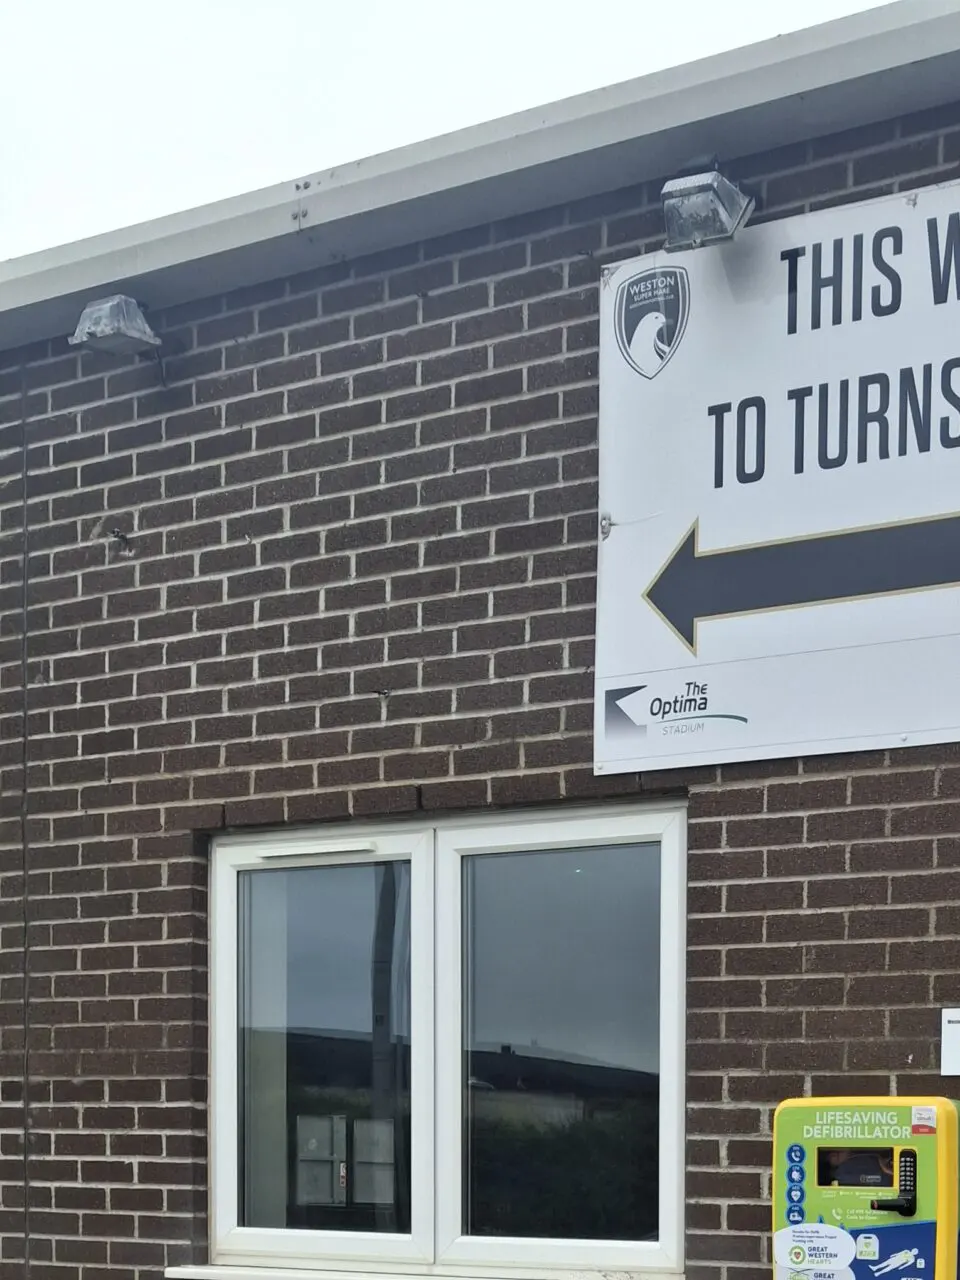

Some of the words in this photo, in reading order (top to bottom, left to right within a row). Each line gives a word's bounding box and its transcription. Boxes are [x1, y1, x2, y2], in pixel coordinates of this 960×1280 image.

[629, 275, 675, 296] WESTON
[780, 226, 903, 335] THIS
[634, 290, 653, 302] SUPER
[708, 396, 766, 489] TO
[685, 681, 708, 697] The
[650, 695, 708, 720] Optima
[662, 723, 705, 736] STADIUM
[815, 1111, 898, 1125] LIFESAVING
[803, 1125, 911, 1139] DEFIBRILLATOR
